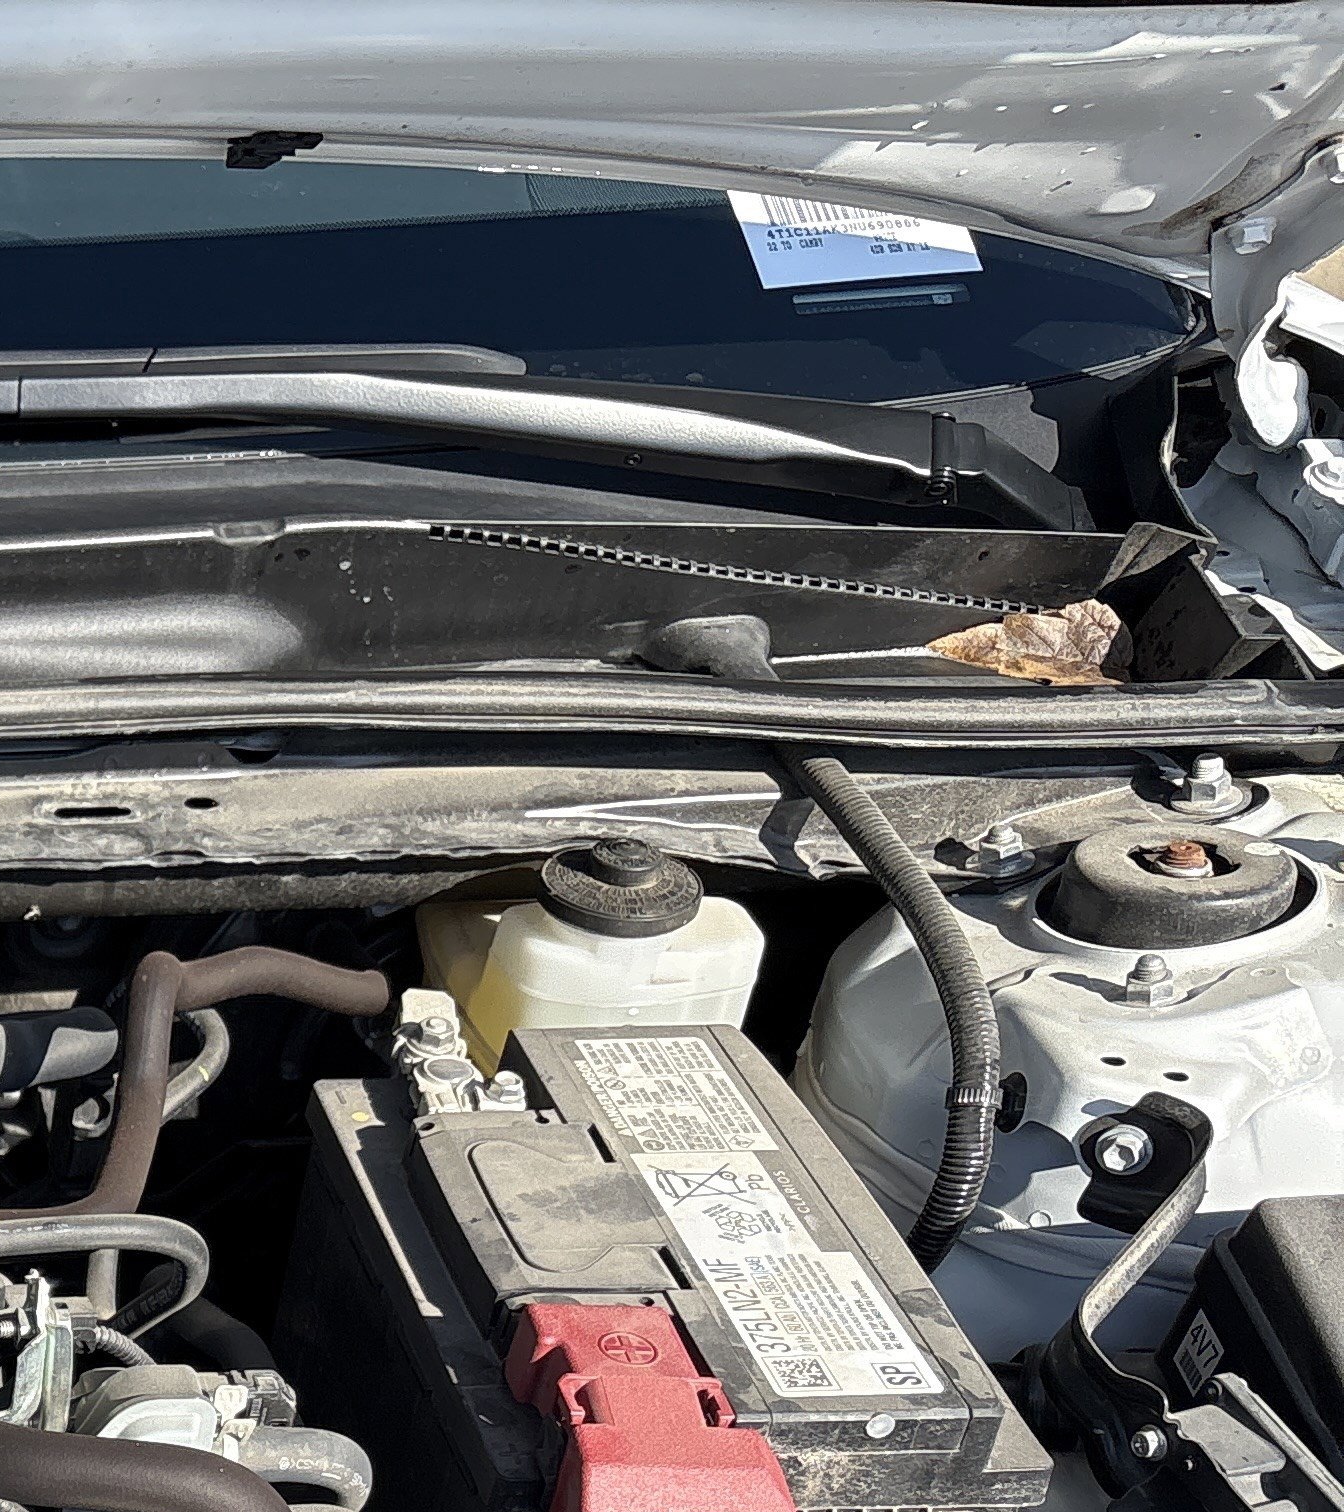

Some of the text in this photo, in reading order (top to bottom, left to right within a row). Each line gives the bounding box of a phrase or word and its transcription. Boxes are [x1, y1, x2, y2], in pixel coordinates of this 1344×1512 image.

[745, 1174, 770, 1190] Pb
[773, 1170, 811, 1214] CLARIOS
[702, 1259, 791, 1352] 375LN2-MF
[1191, 1323, 1219, 1369] 4V7
[879, 1365, 923, 1386] SP
